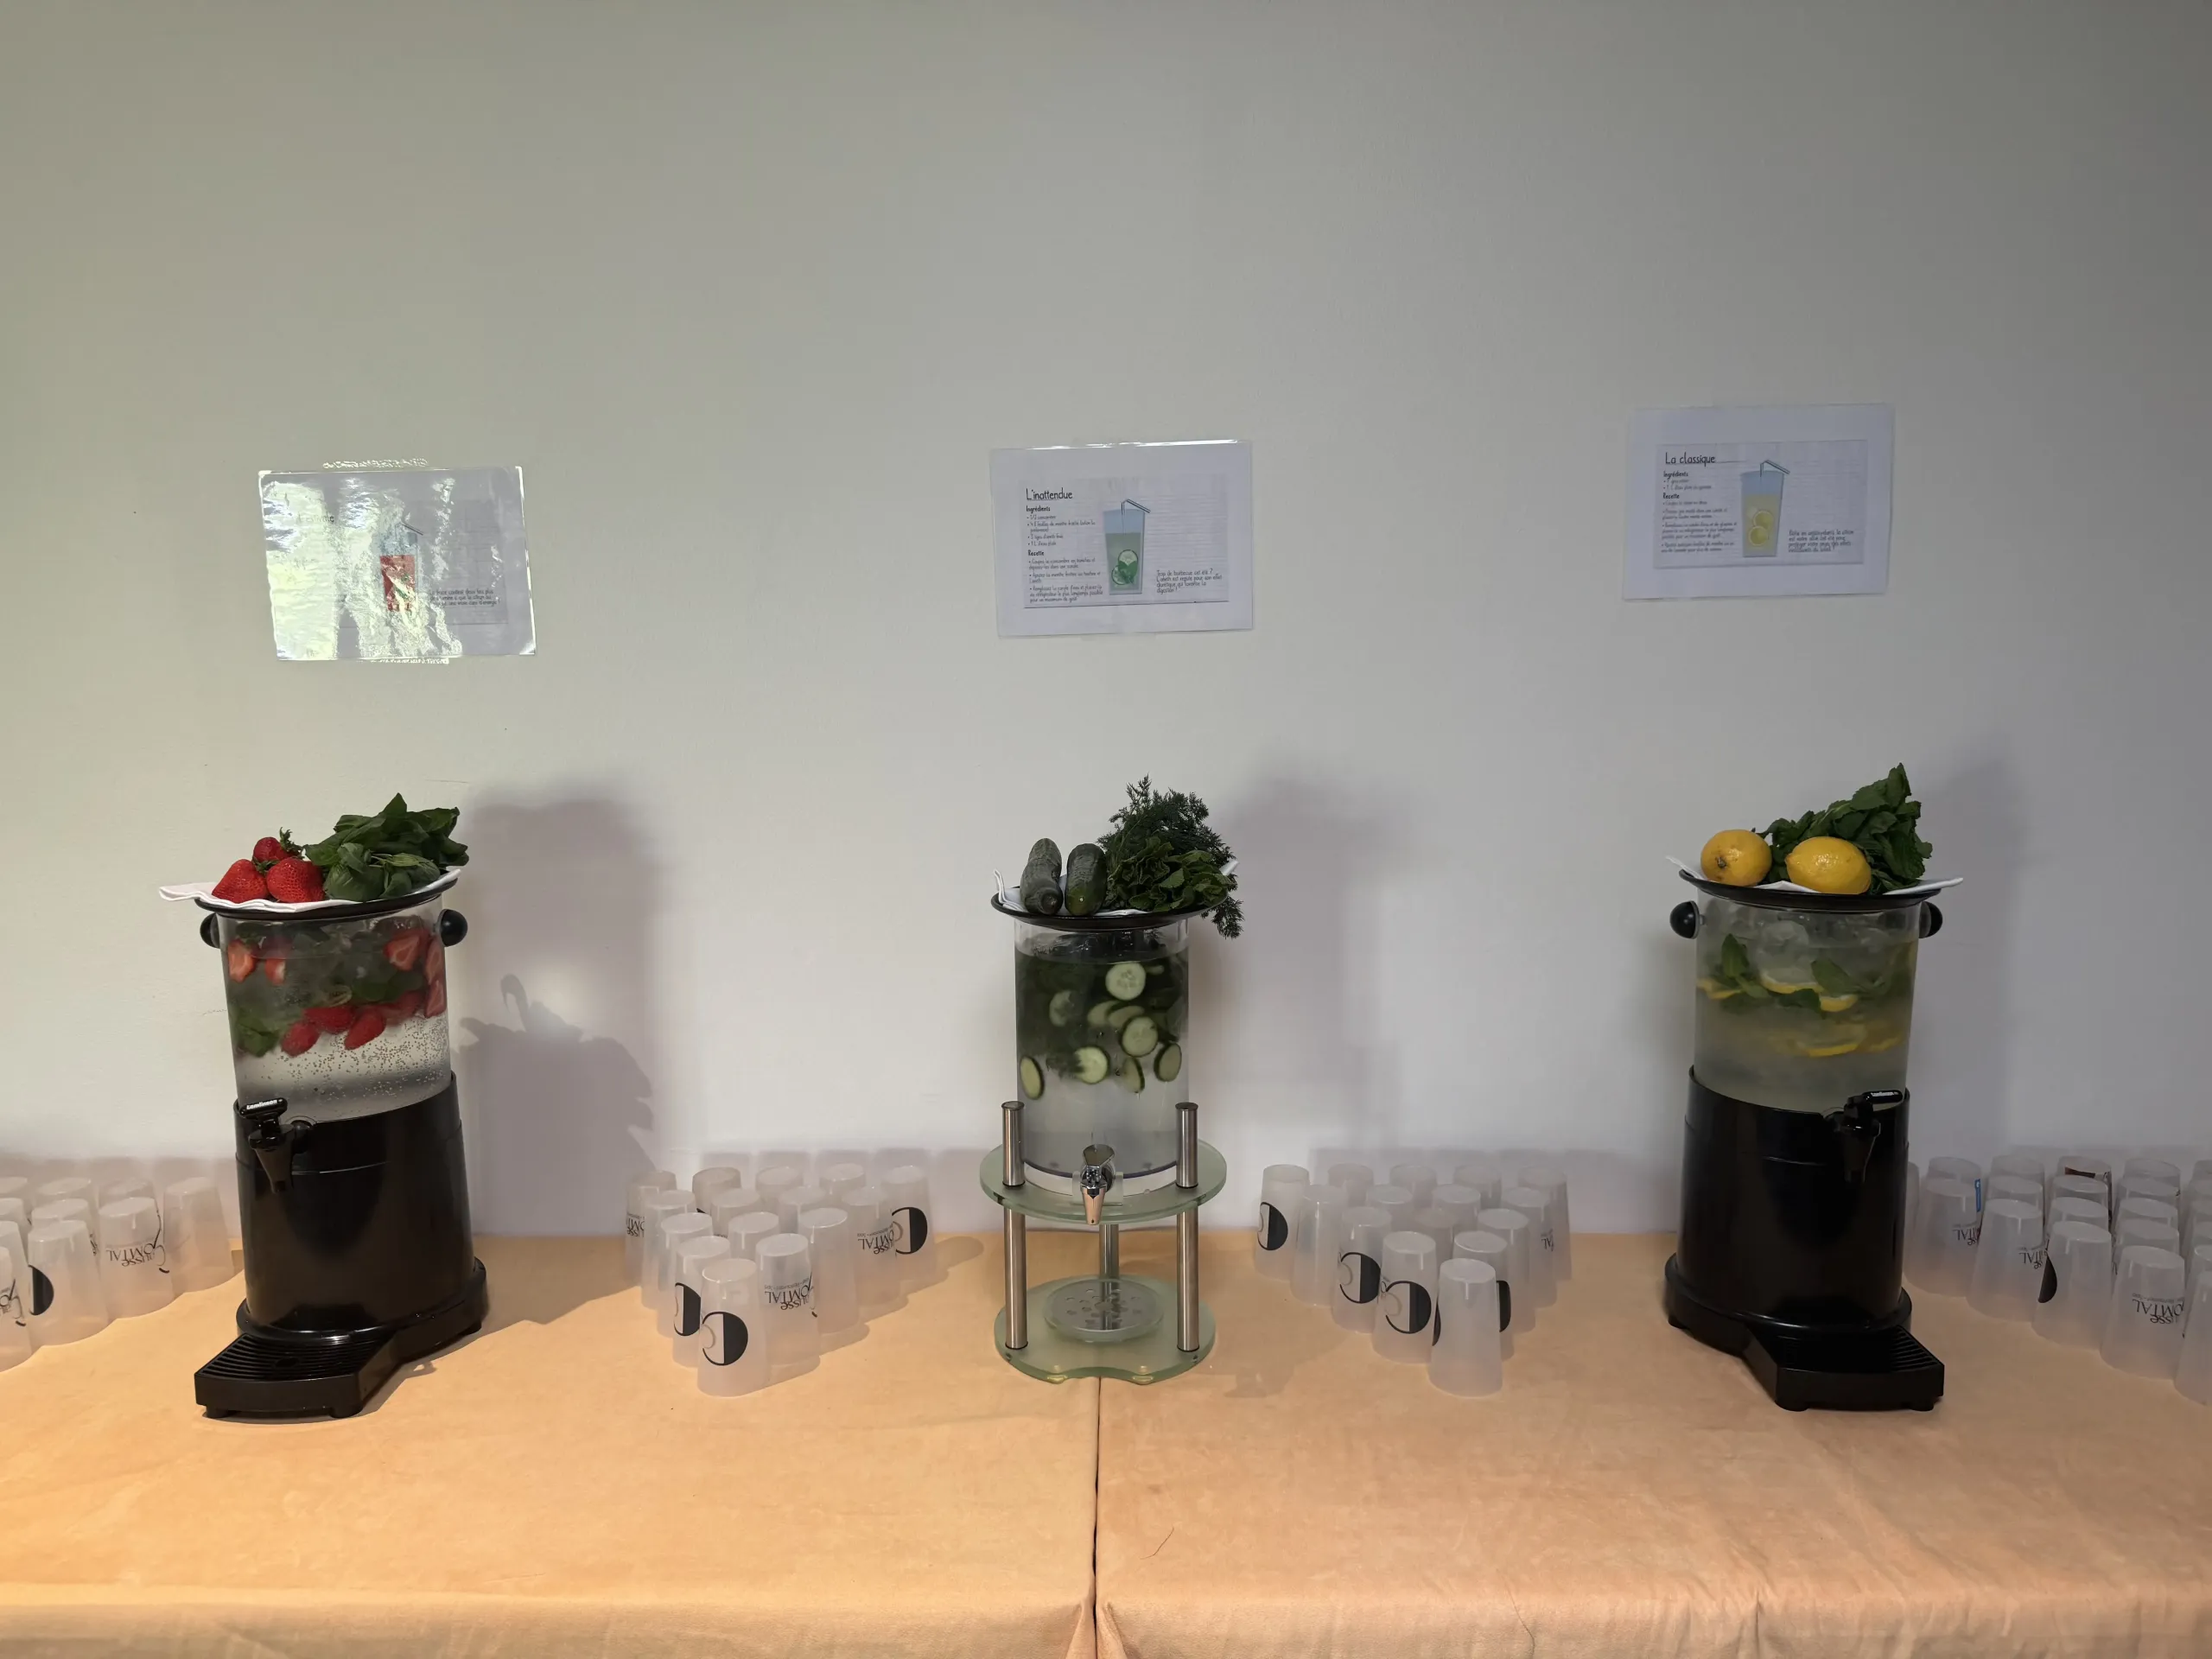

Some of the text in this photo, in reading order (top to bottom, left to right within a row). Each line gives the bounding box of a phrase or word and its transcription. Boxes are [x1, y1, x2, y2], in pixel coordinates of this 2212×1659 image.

[1666, 451, 1716, 467] La classique
[1663, 470, 1688, 480] Ingrédients
[1027, 487, 1073, 500] L'inattendue
[1027, 505, 1051, 514] Ingrédients
